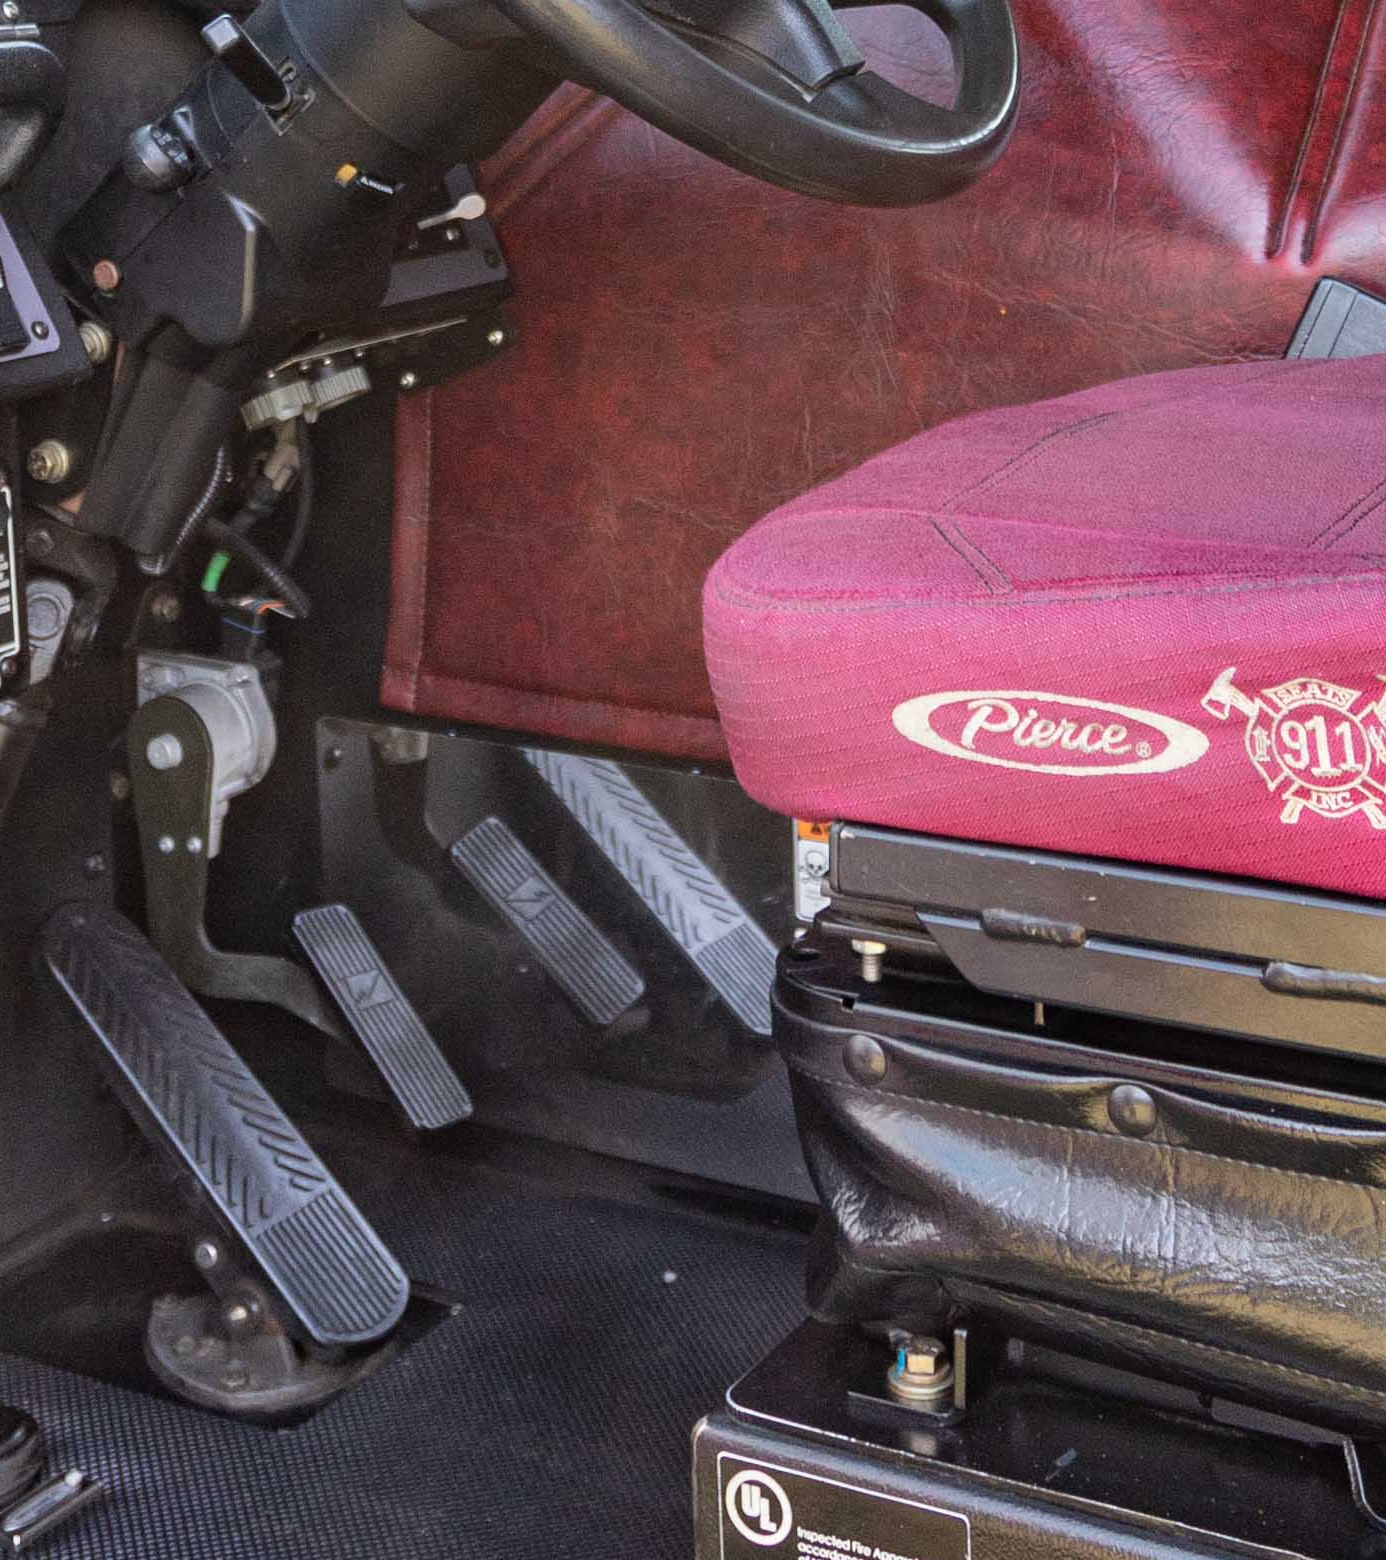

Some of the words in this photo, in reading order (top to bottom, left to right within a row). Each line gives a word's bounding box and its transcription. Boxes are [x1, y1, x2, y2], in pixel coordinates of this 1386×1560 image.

[1279, 683, 1354, 706] SEATS
[962, 699, 1132, 755] Pierce
[1280, 715, 1363, 778] 911
[1310, 792, 1353, 811] INC
[741, 1483, 777, 1533] UL
[797, 1526, 850, 1551] Inspected
[852, 1541, 871, 1557] Fire
